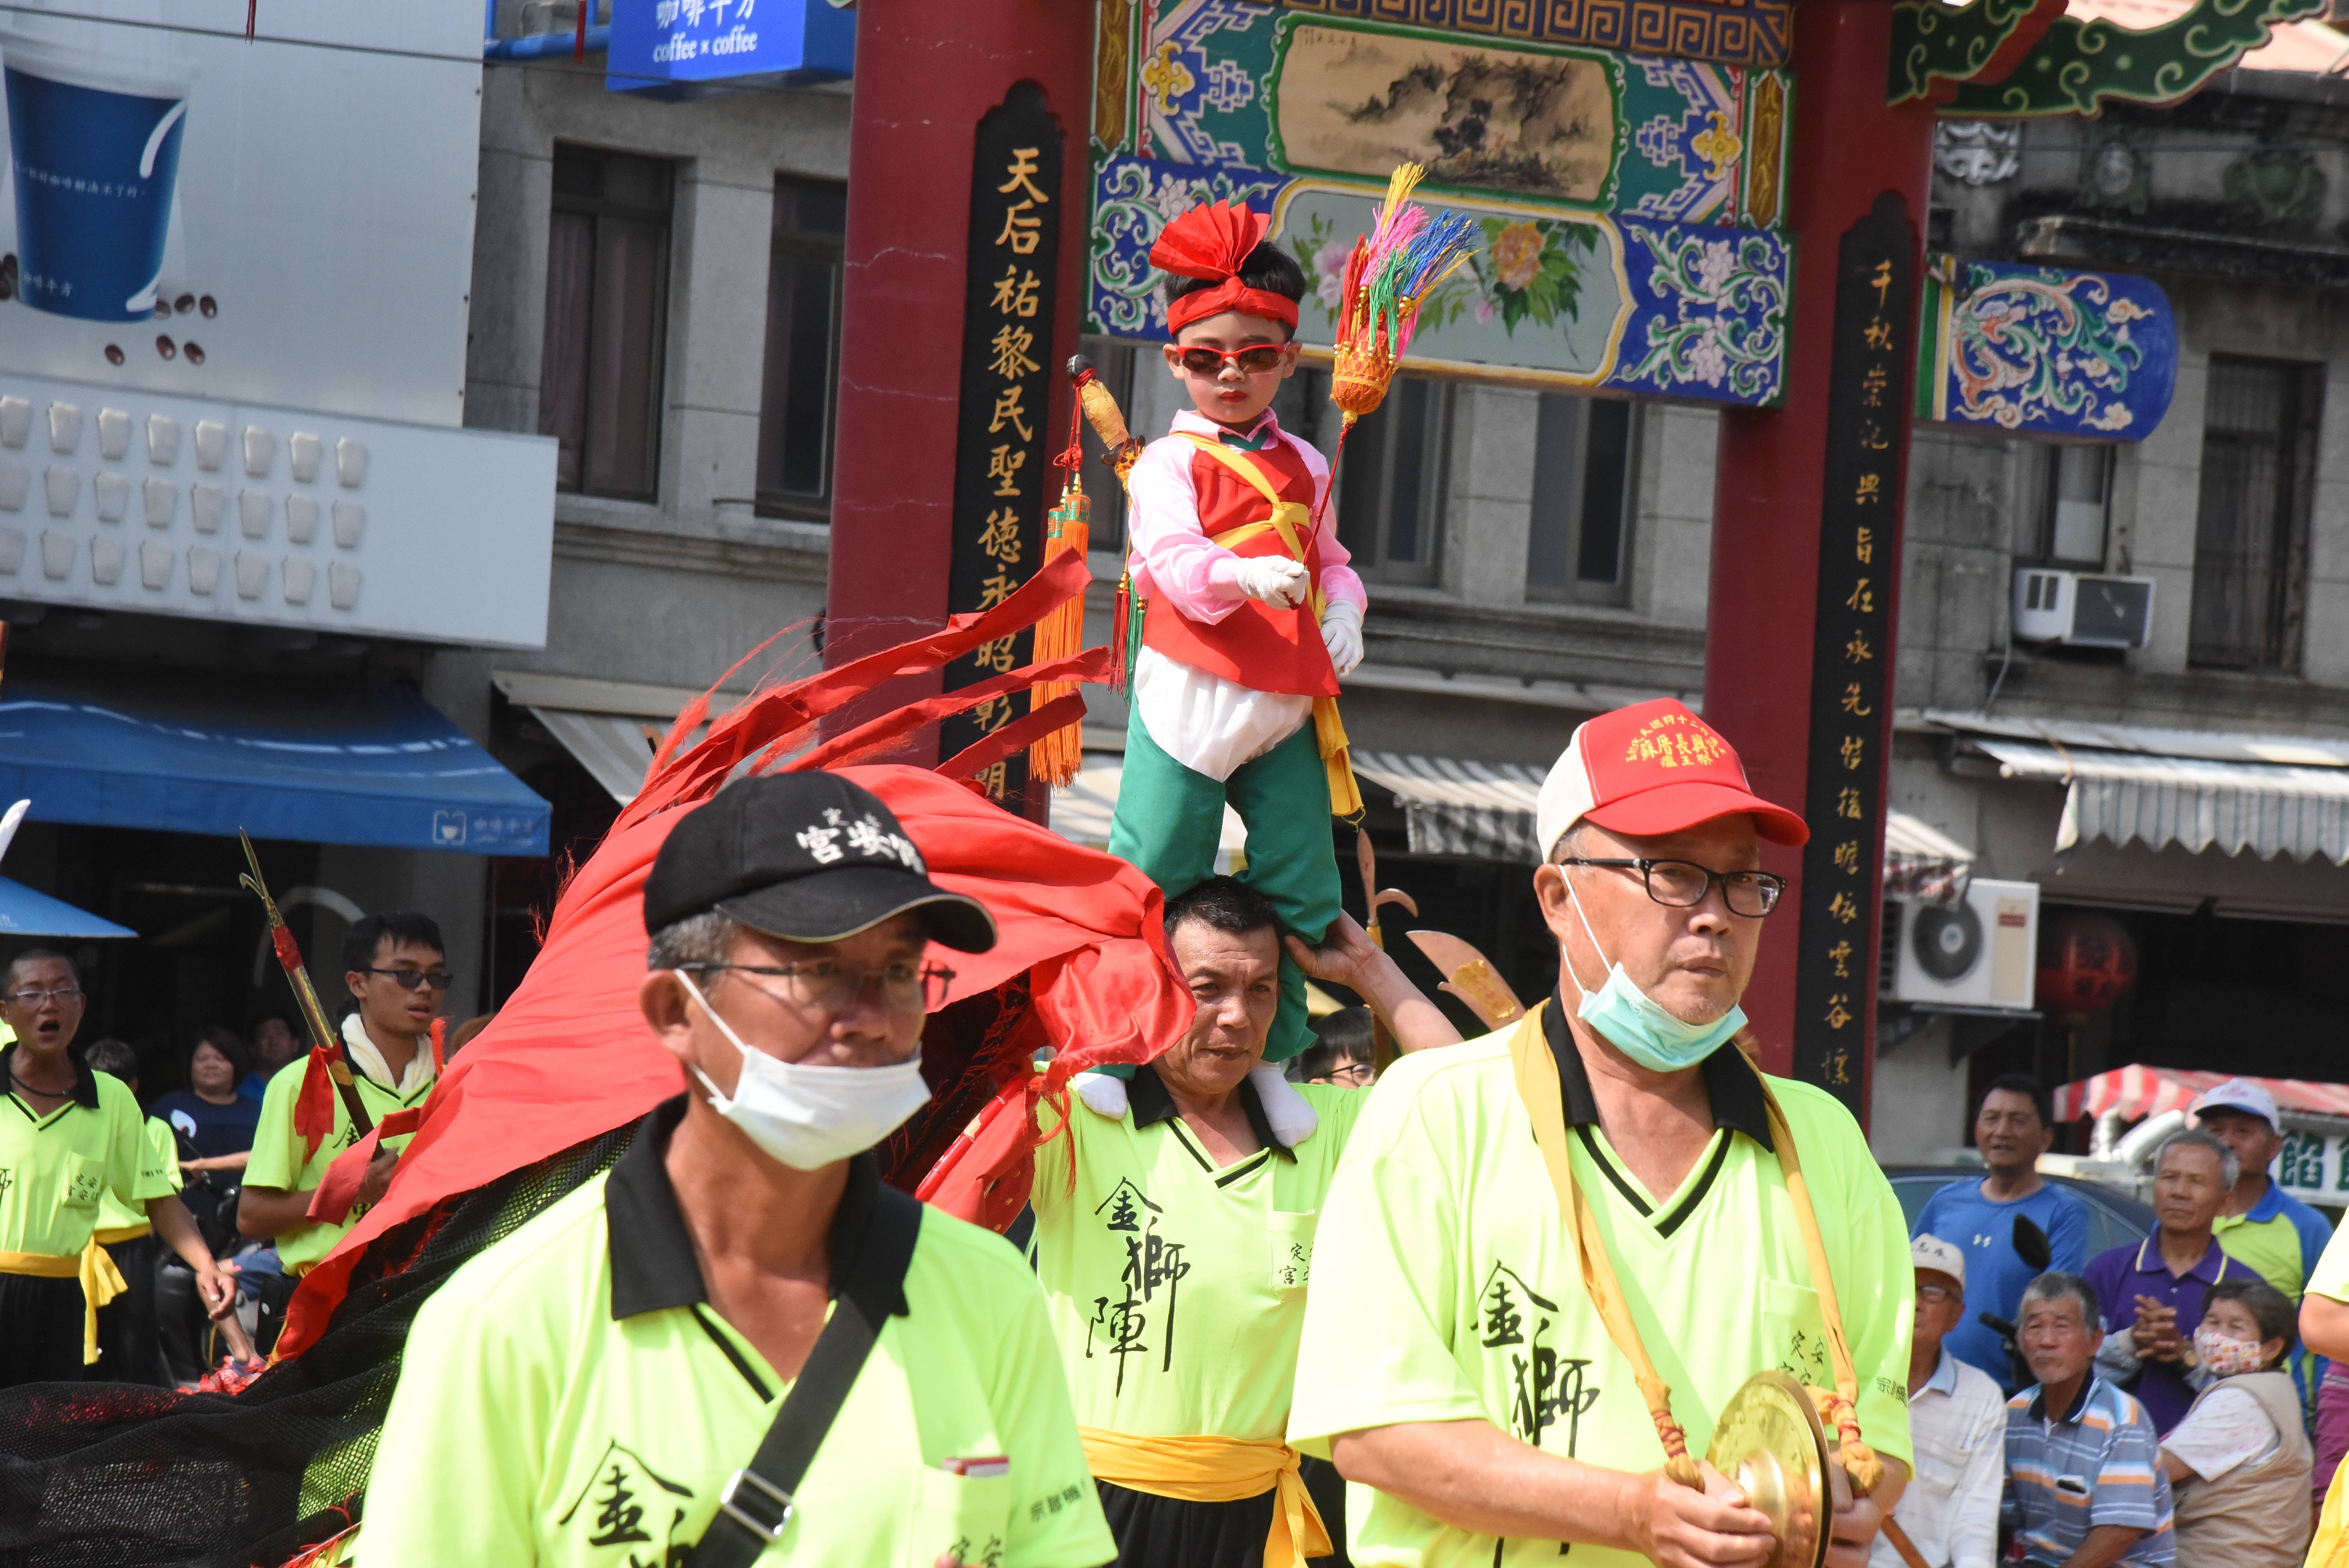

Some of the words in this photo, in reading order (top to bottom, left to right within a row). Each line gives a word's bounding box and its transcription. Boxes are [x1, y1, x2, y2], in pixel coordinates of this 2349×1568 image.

[653, 31, 686, 62] coffee
[713, 24, 758, 55] coffee
[1086, 1176, 1191, 1398] 金獅陣
